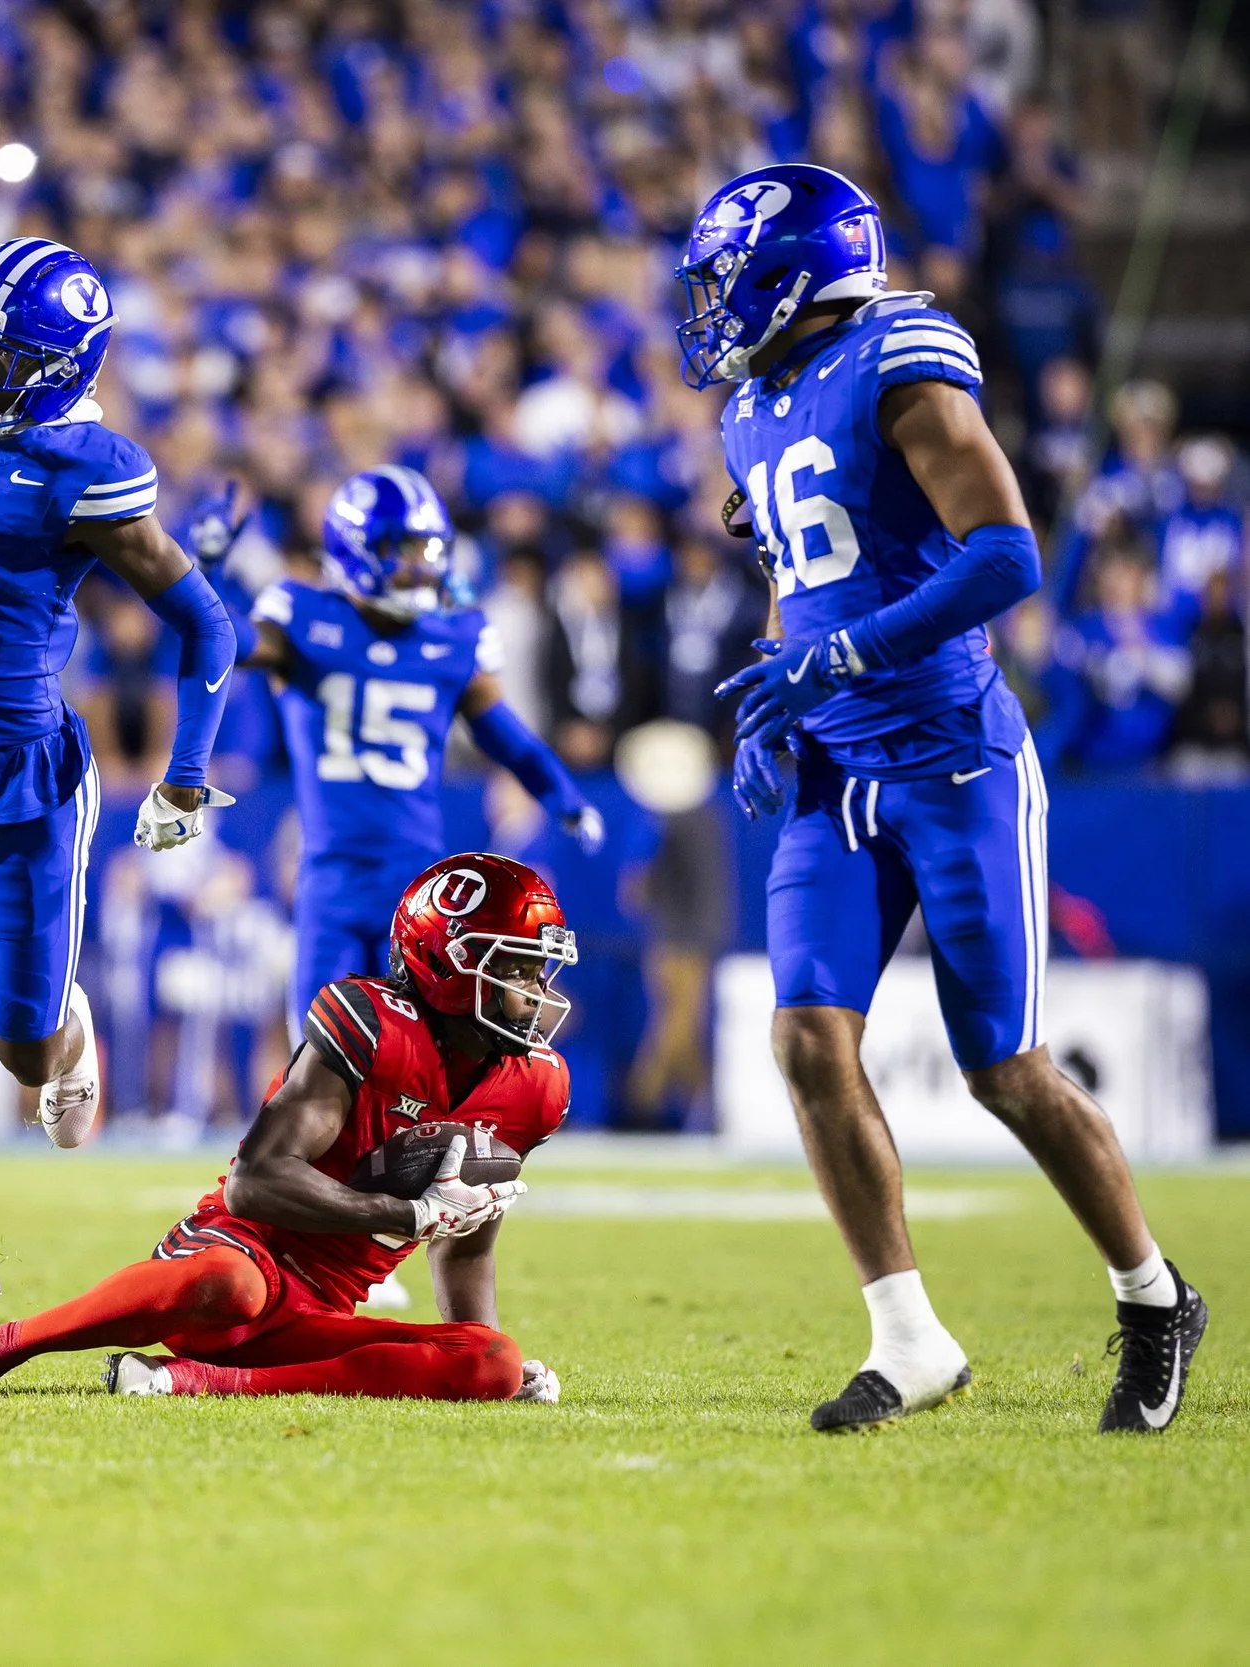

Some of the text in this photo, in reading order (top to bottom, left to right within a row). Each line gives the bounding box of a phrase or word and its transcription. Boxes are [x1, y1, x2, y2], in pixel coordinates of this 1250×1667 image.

[725, 184, 777, 222] Y
[67, 277, 100, 317] Y
[746, 434, 861, 599] 16
[316, 671, 437, 791] 15
[438, 873, 484, 913] U
[389, 1094, 428, 1121] XII
